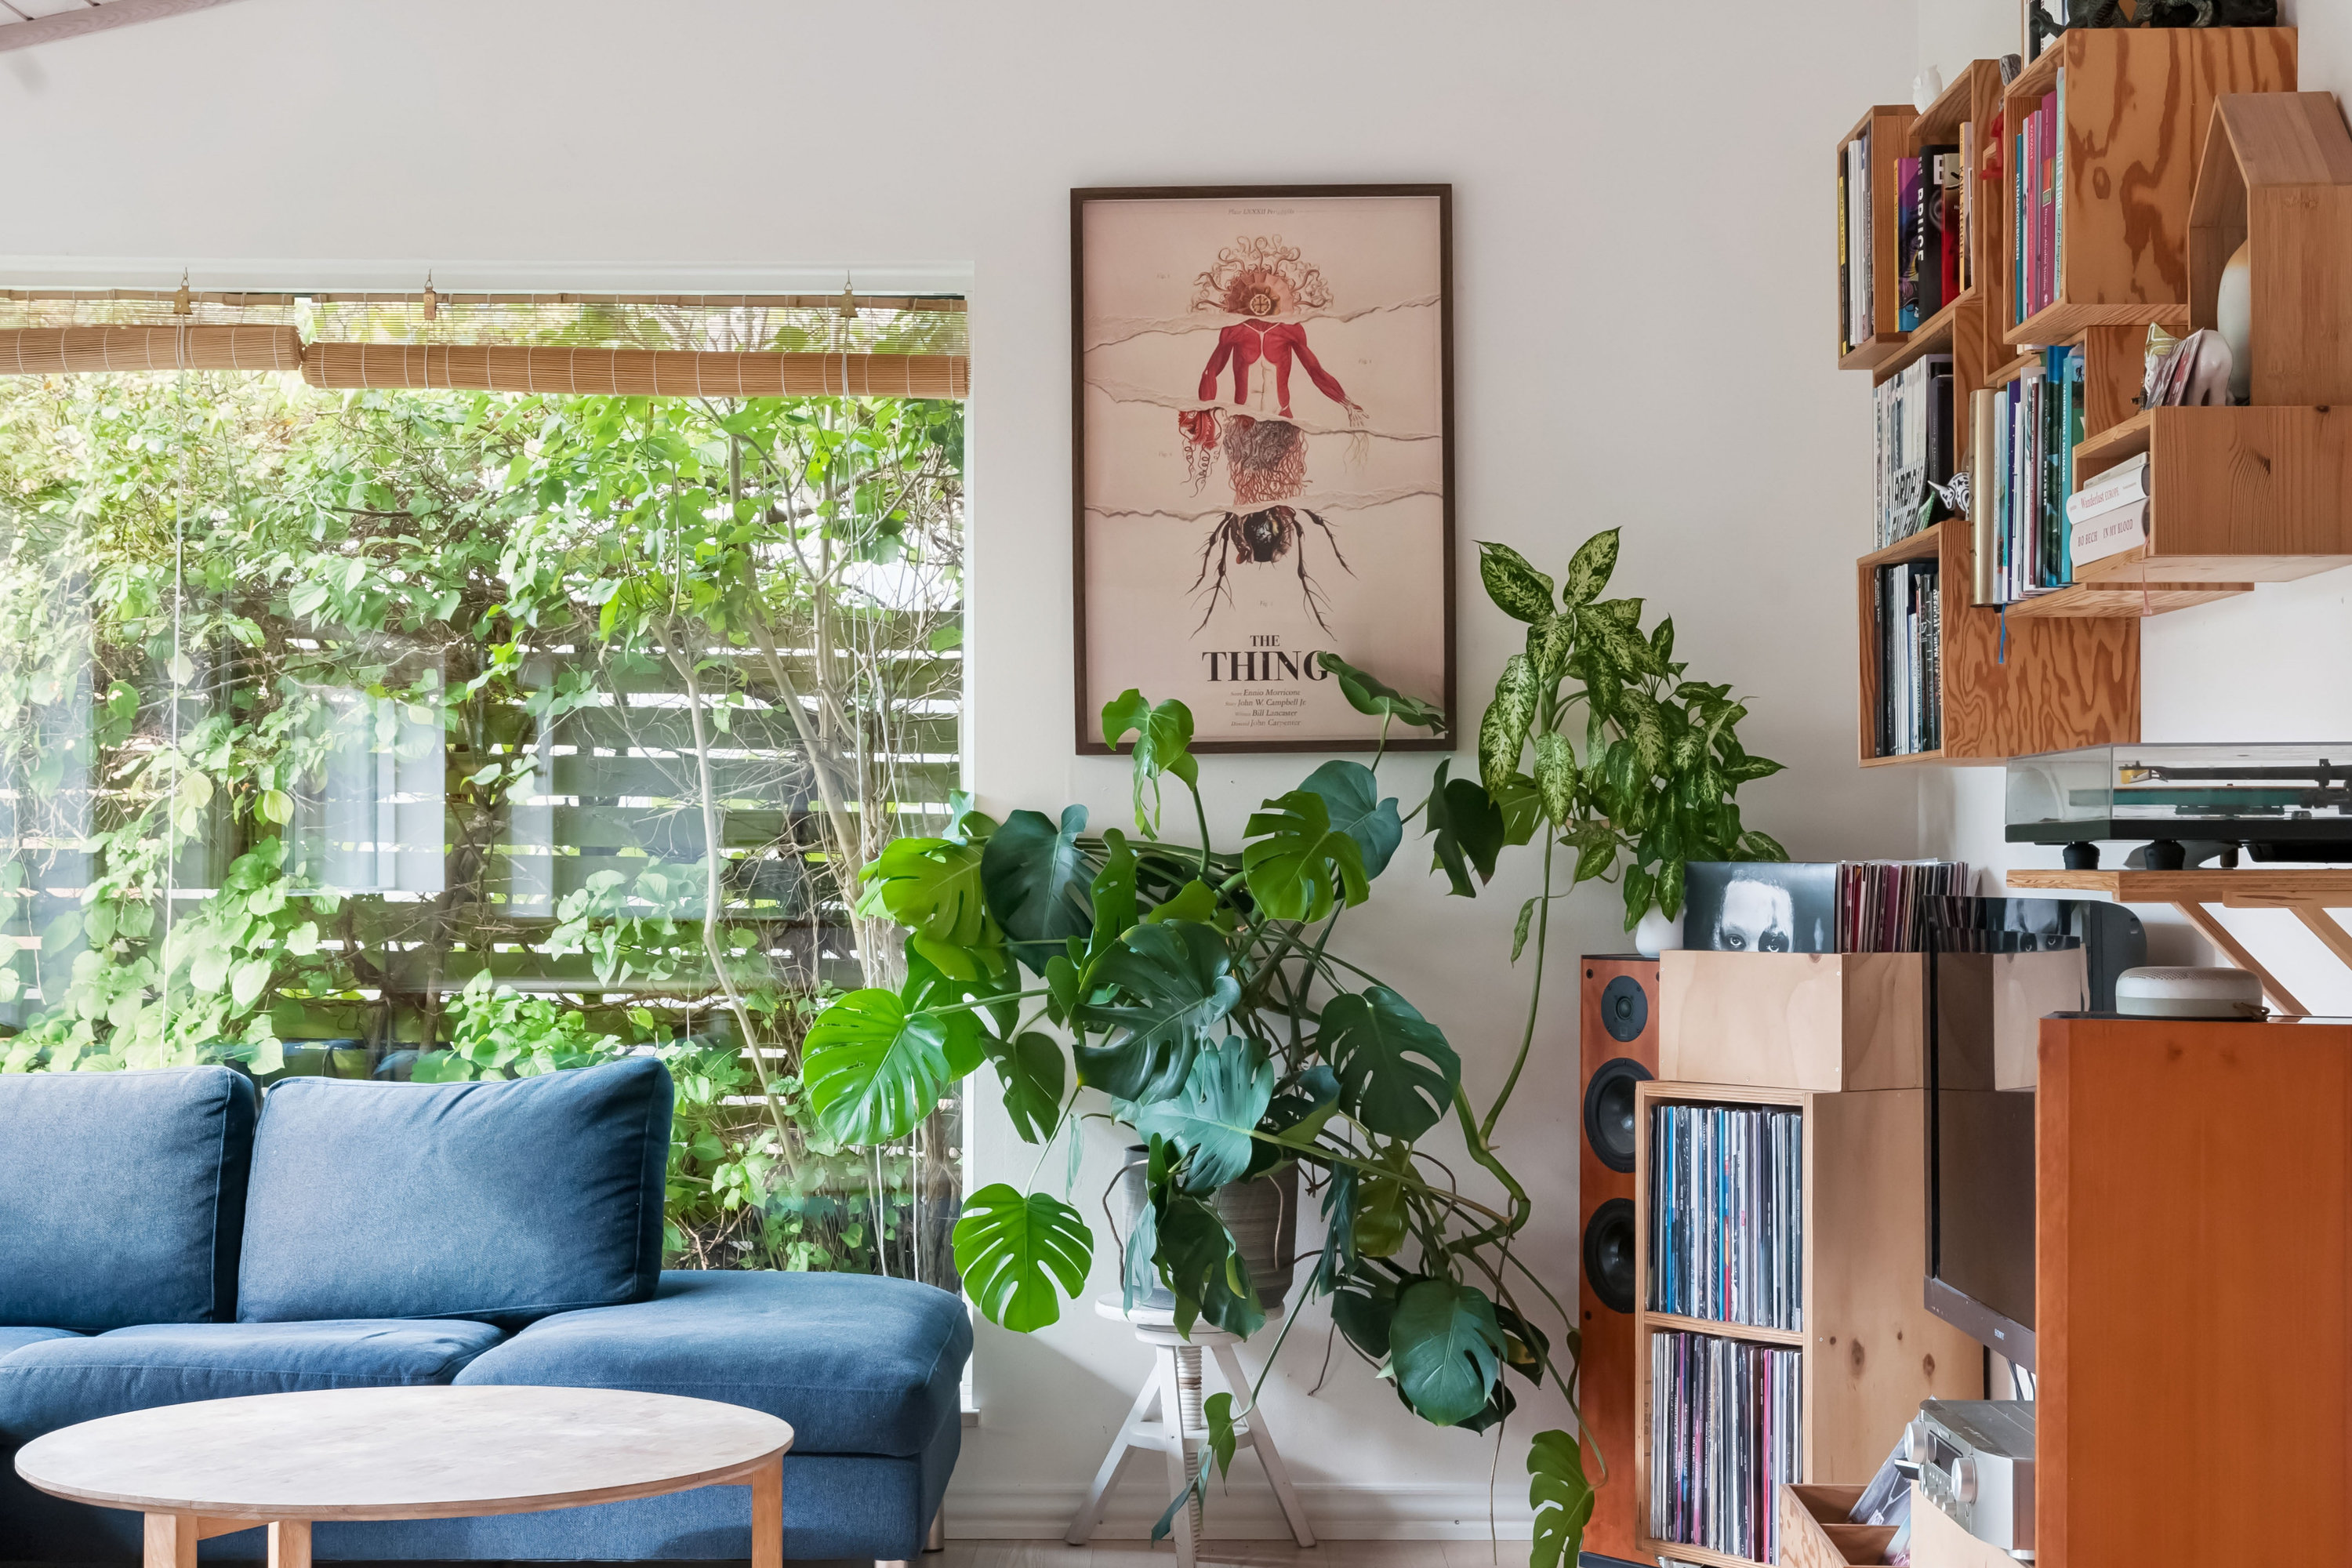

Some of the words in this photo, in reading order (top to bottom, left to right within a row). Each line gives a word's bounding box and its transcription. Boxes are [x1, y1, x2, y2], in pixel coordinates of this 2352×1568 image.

[2081, 490, 2104, 509] Wanderlust
[2105, 486, 2119, 502] EUROPE
[2078, 535, 2085, 547] BO
[2085, 531, 2098, 544] BECH
[2103, 528, 2109, 539] IN
[2109, 524, 2117, 536] MY
[2118, 518, 2133, 535] BLOOD
[1249, 635, 1280, 648] THE
[1201, 650, 1328, 682] THING
[1237, 699, 1254, 707] John
[1265, 699, 1298, 708] Campbell
[1250, 719, 1266, 728] John
[1267, 719, 1302, 728] Carpenter
